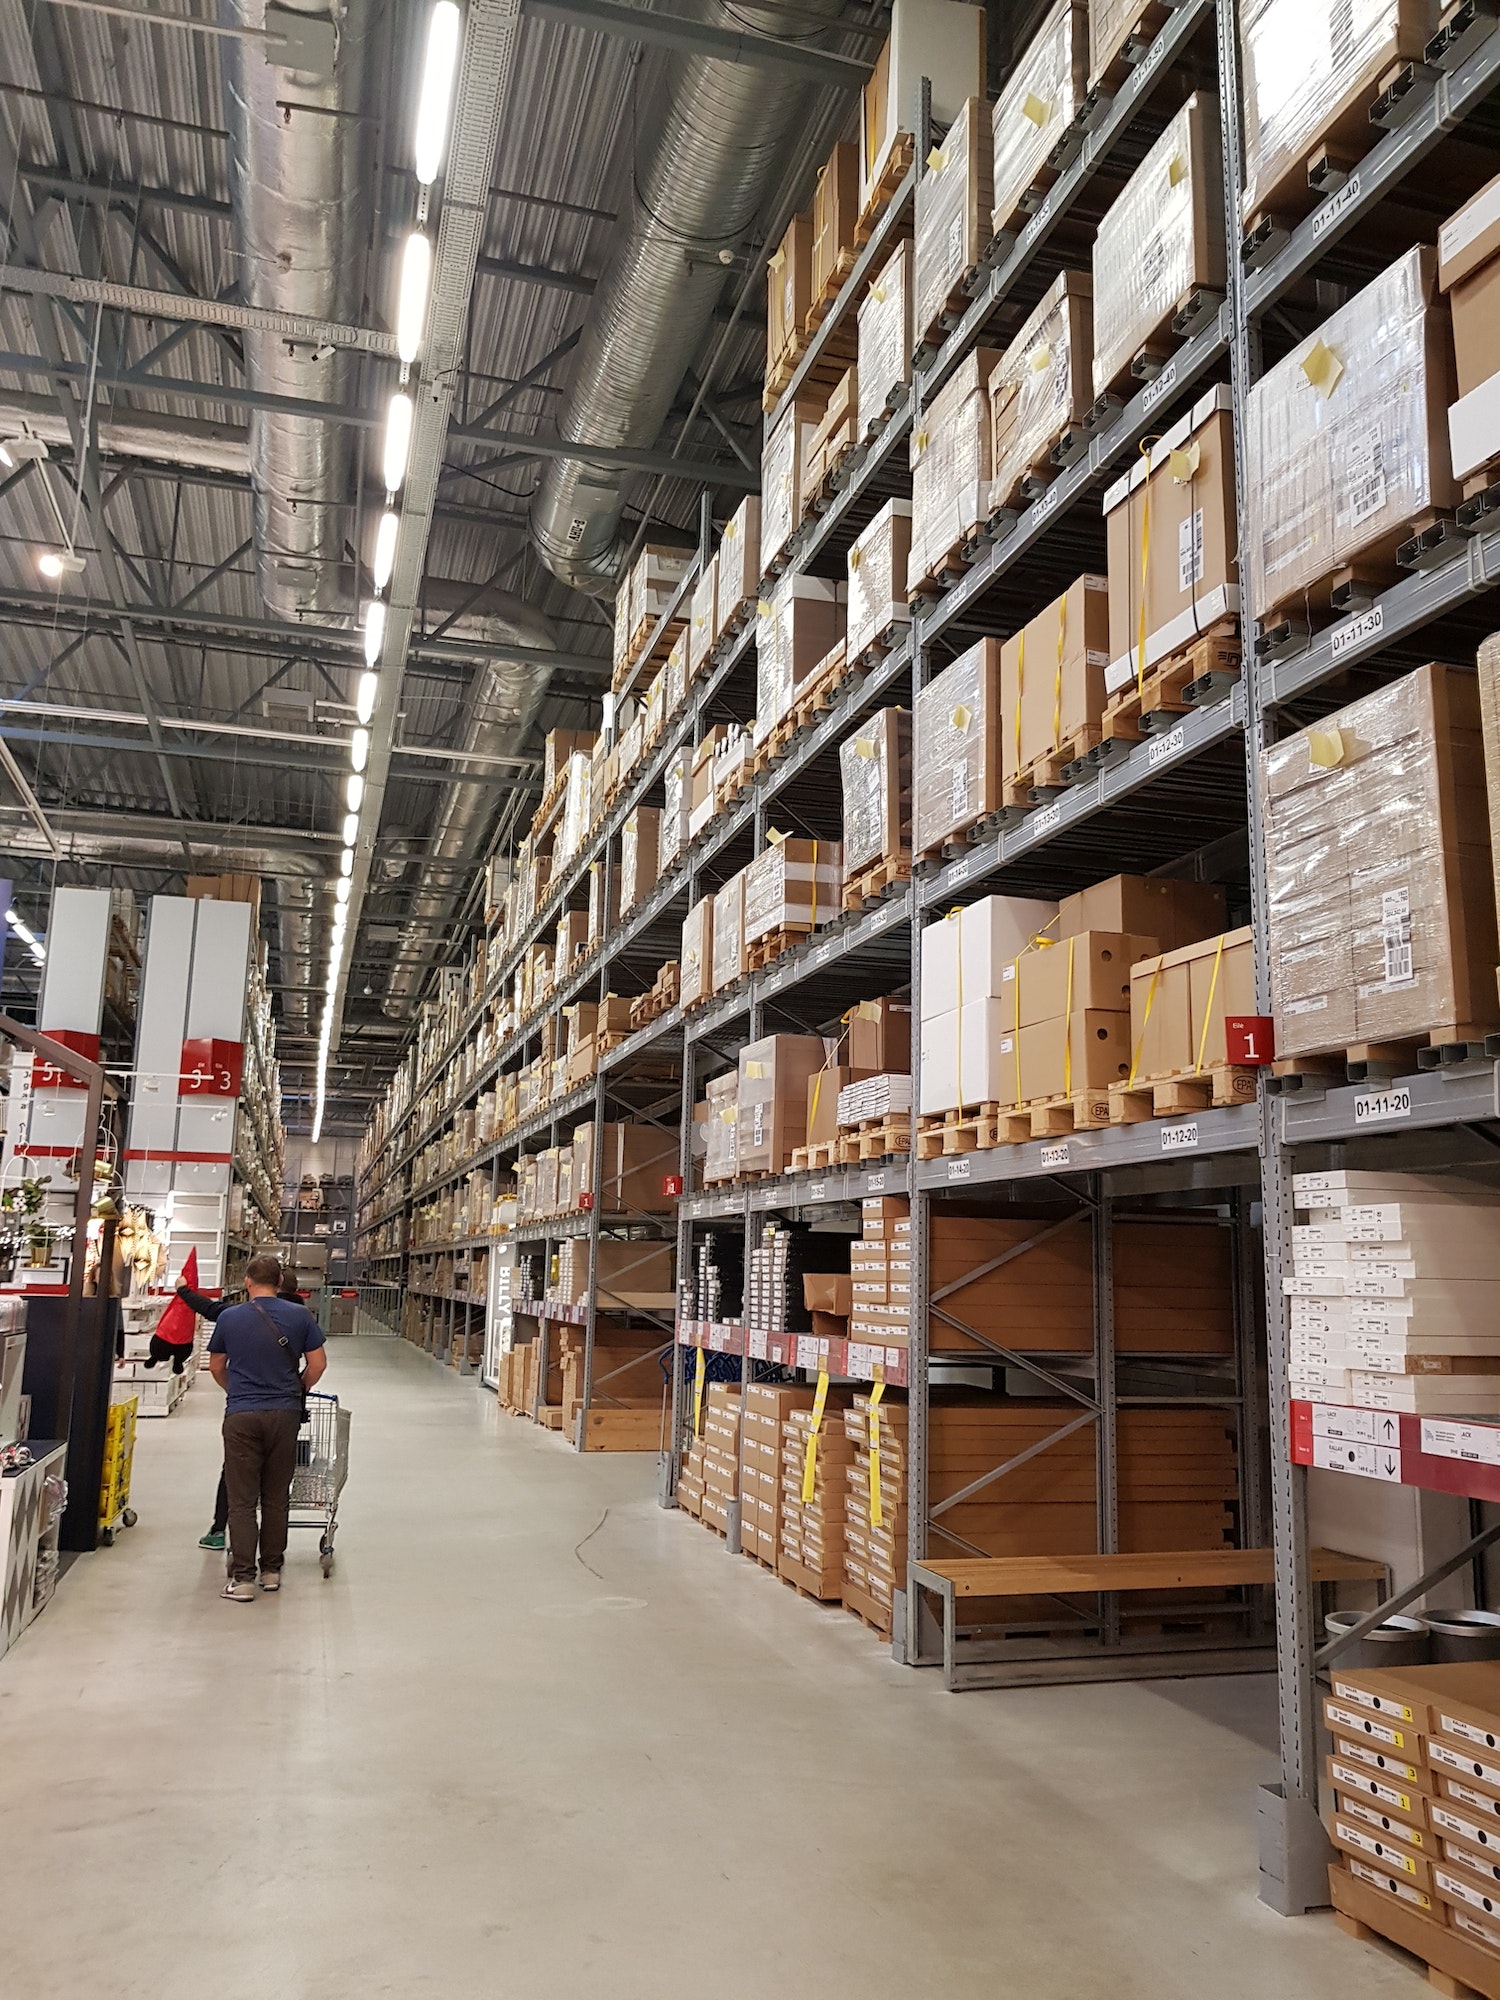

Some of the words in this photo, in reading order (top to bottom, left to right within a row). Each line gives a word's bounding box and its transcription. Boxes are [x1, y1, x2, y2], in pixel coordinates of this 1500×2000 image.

[1133, 41, 1164, 88] 01-12-50
[1313, 180, 1359, 233] 01-11-40
[1143, 368, 1175, 407] 01-12-40
[1333, 612, 1382, 650] 01-11-30
[1150, 732, 1183, 759] 01-12-30
[1243, 1032, 1260, 1059] 1
[220, 1070, 231, 1090] 3
[1356, 1093, 1410, 1117] 01-11-20
[1162, 1127, 1197, 1145] 01-12-20
[1042, 1148, 1069, 1163] 01-13-20
[583, 1198, 589, 1207] 1
[498, 1266, 511, 1315] BILLY
[1405, 1709, 1411, 1718] 3
[1394, 1735, 1399, 1744] 1
[1410, 1768, 1415, 1777] 3
[1401, 1797, 1405, 1807] 1
[1415, 1833, 1421, 1842] 3
[1423, 1896, 1429, 1905] 3
